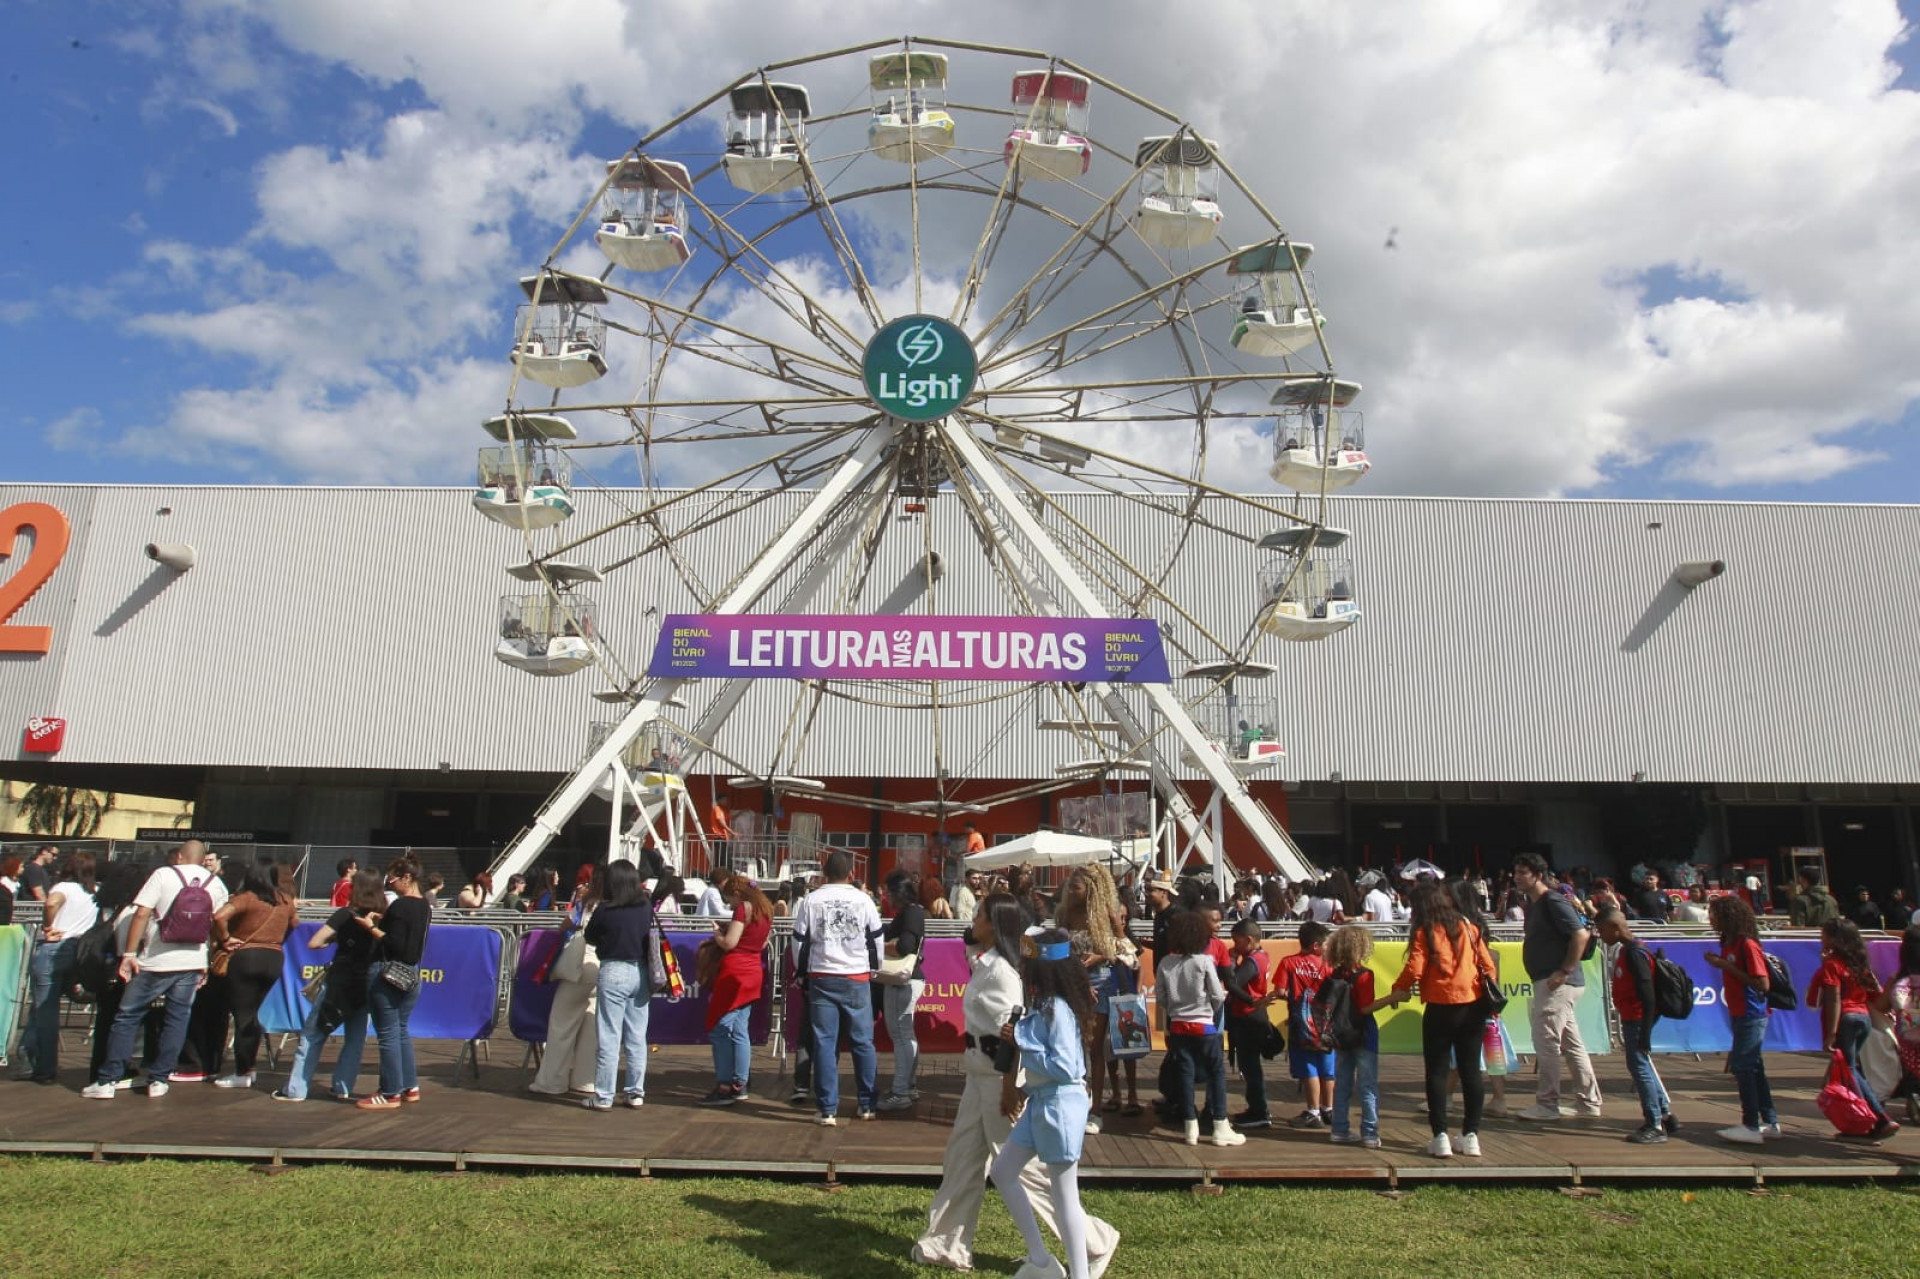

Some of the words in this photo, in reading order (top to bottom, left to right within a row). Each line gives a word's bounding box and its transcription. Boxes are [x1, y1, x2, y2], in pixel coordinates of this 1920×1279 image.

[879, 372, 962, 407] Light
[0, 501, 70, 652] 2
[673, 628, 712, 638] BIENAL
[1104, 632, 1145, 643] BIENAL
[673, 638, 689, 648] DO
[1105, 643, 1121, 652] DO
[672, 648, 706, 657] LIVRO
[729, 629, 890, 668] LEITURA
[893, 629, 912, 668] NAS
[912, 630, 1087, 671] ALTURAS
[1105, 653, 1139, 662] LIVRO
[938, 983, 968, 997] LIV
[1504, 983, 1532, 997] IVR
